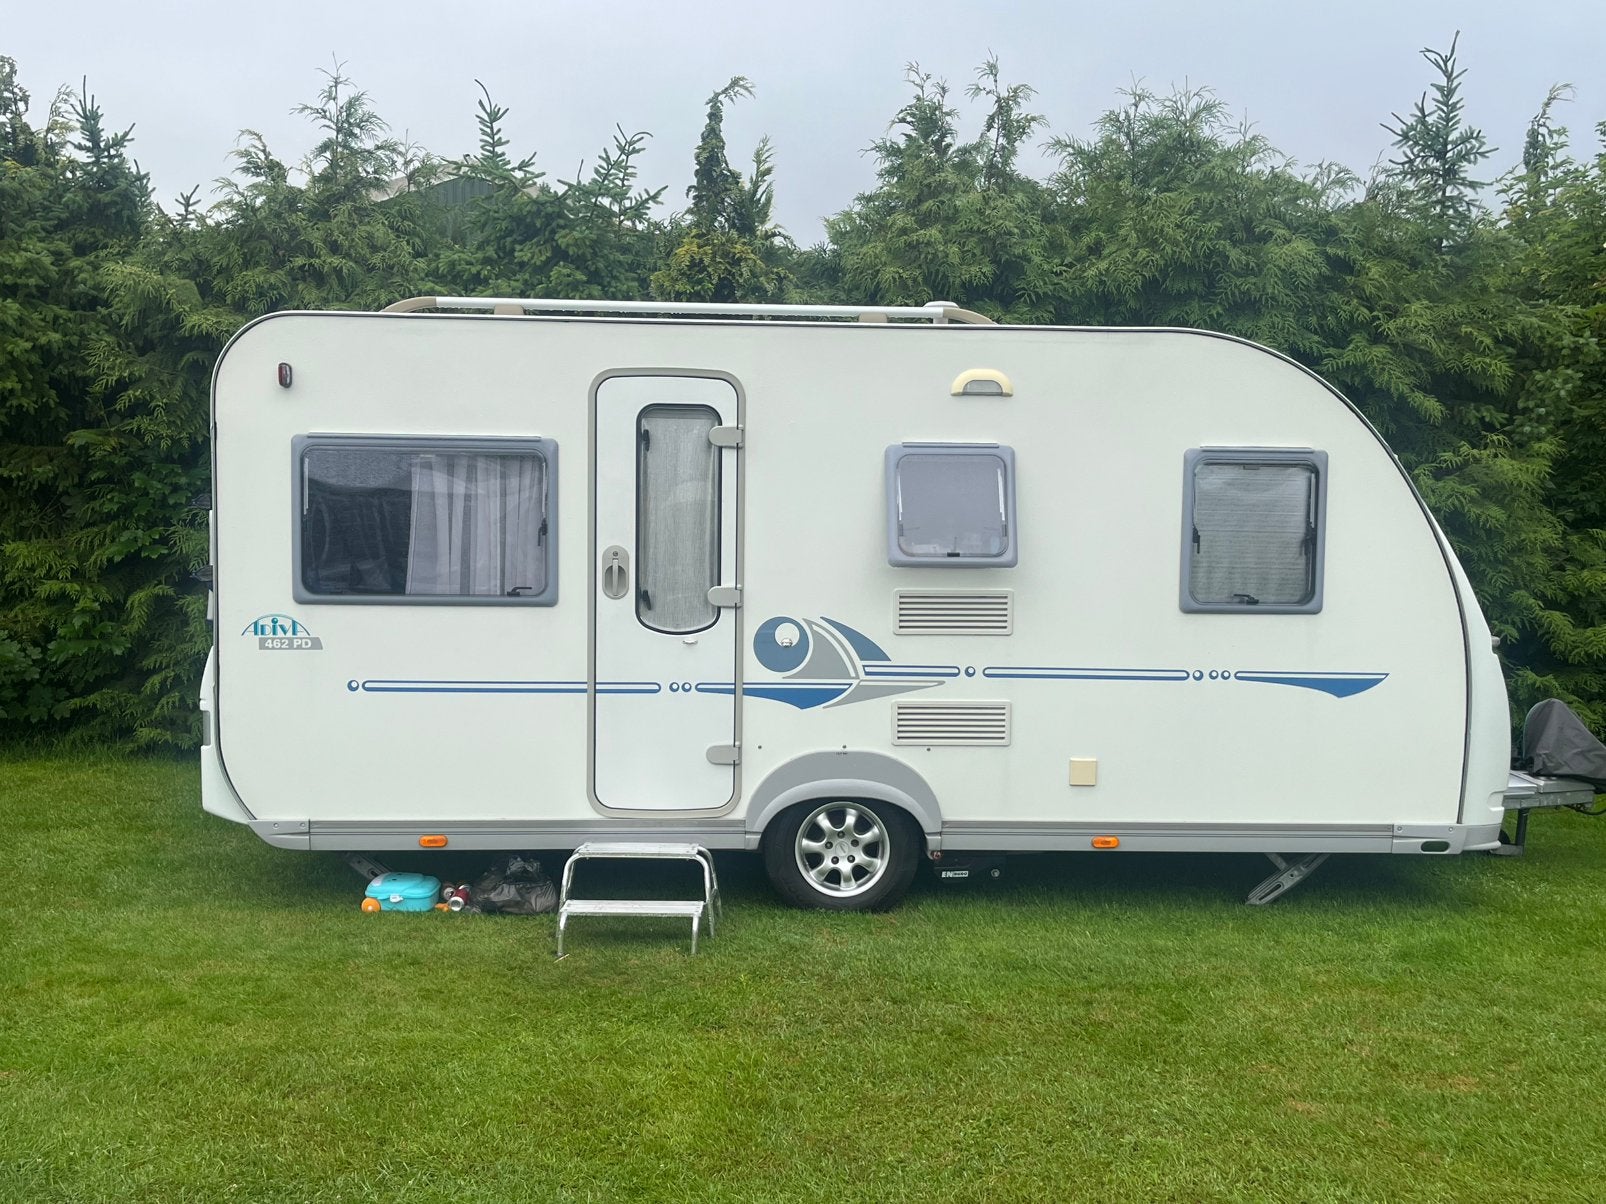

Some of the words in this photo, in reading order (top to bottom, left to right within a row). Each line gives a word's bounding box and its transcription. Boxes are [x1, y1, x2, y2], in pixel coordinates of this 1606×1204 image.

[265, 639, 289, 649] 462
[293, 639, 312, 649] PD
[941, 870, 969, 878] ENO
